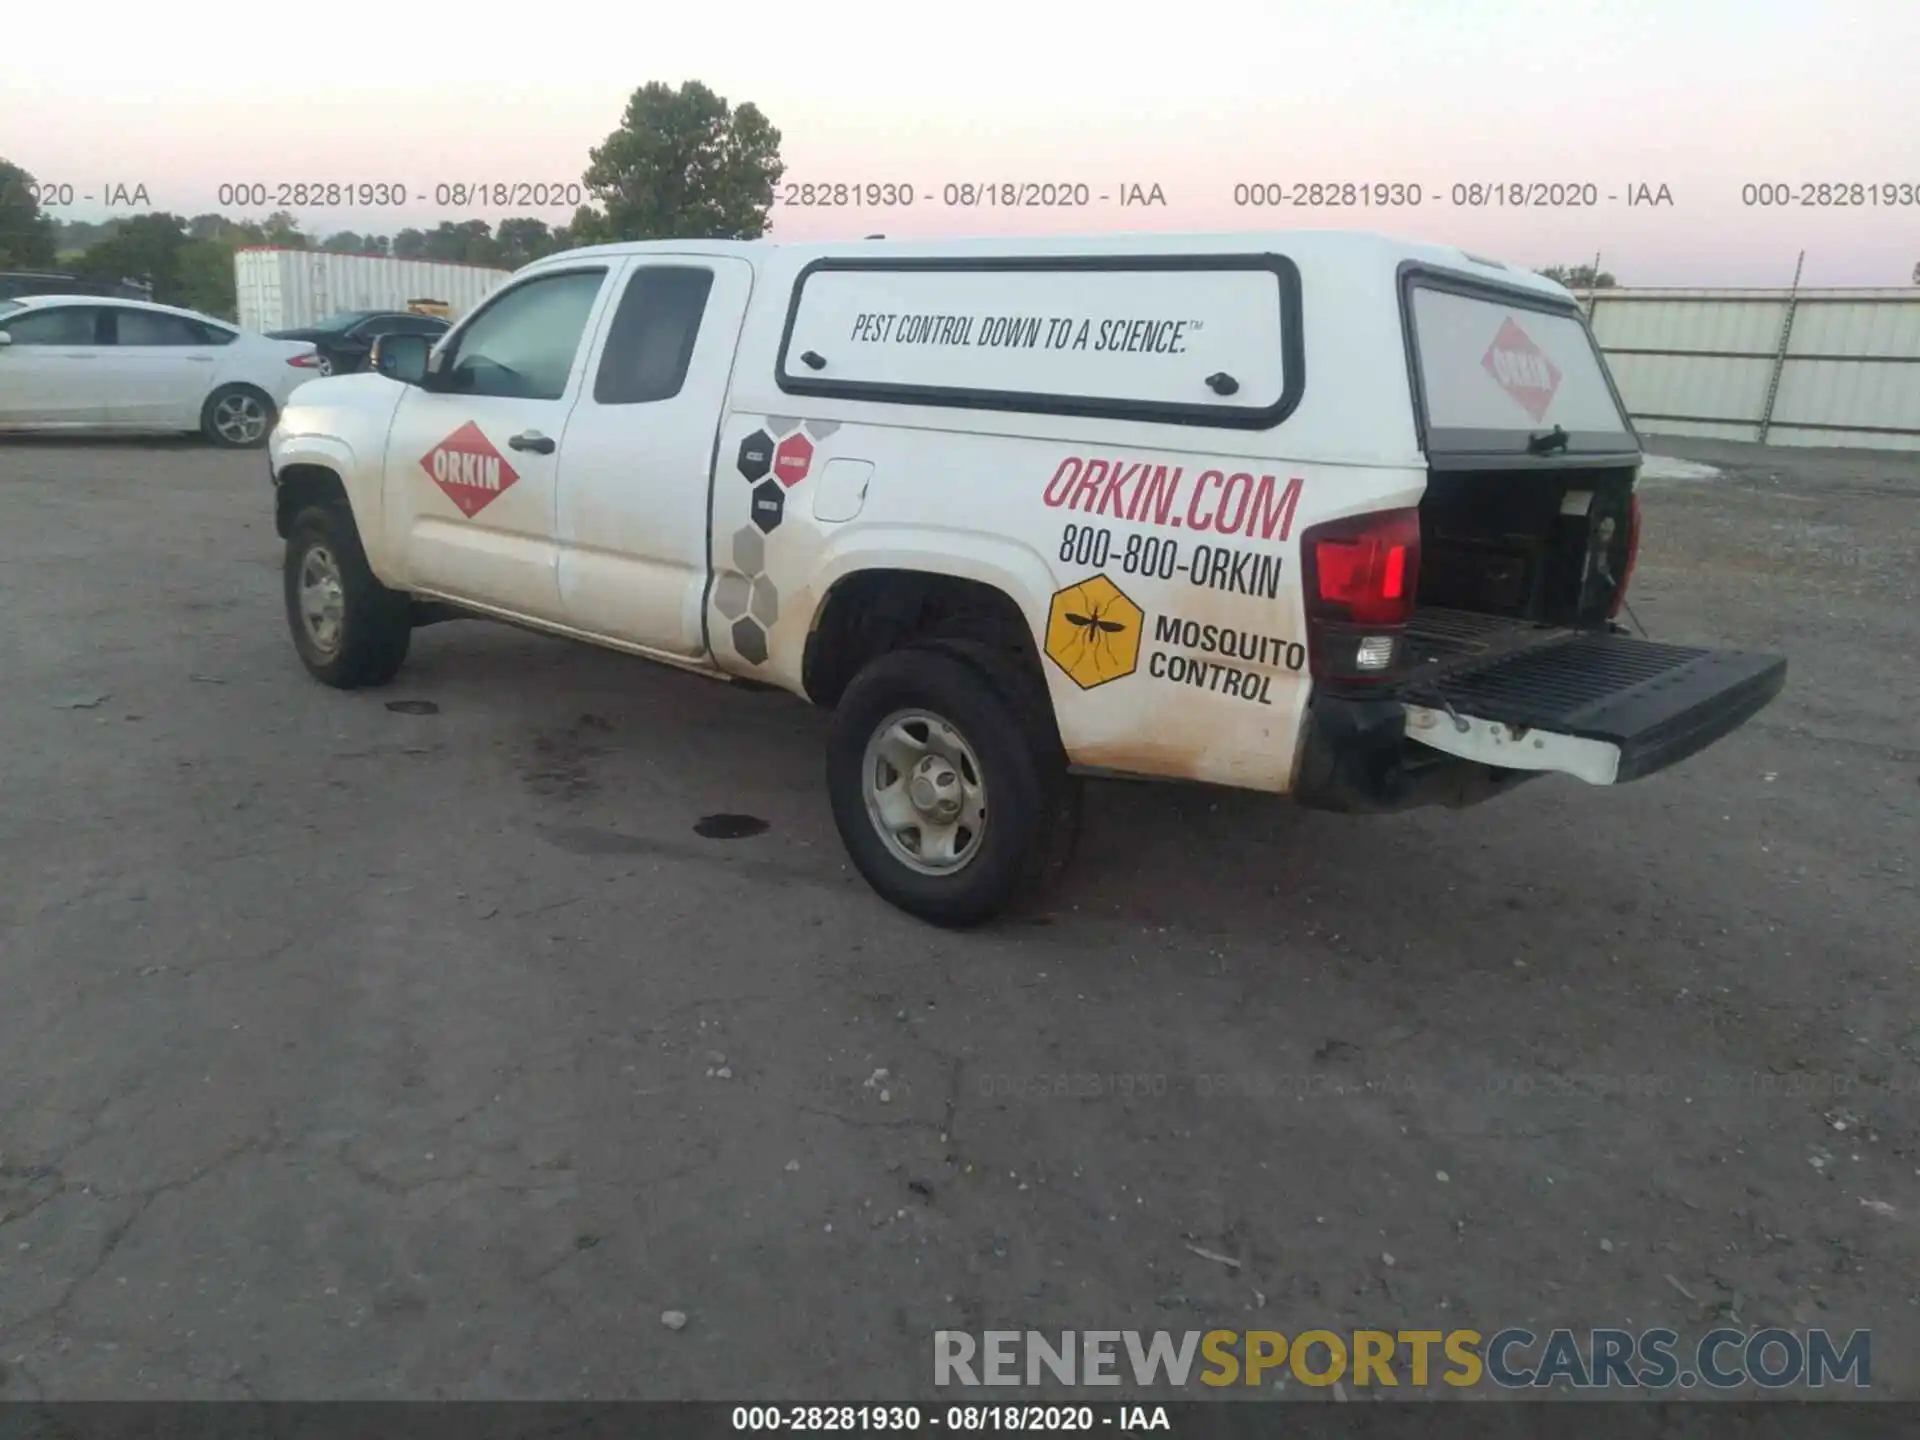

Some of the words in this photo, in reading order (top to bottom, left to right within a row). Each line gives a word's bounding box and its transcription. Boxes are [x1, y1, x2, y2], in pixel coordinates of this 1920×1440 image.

[851, 313, 898, 343] PEST
[895, 314, 974, 346] CONTROL
[977, 316, 1043, 349] DOWN
[1044, 317, 1073, 351] TO
[1072, 318, 1091, 351] A
[1493, 347, 1552, 390] ORKIN
[433, 448, 501, 492] ORKIN
[1043, 456, 1305, 542] ORKIN.COM
[1059, 523, 1283, 600] 800-800-ORKIN
[1154, 614, 1306, 672] MOSQUITO
[1149, 651, 1273, 706] CONTROL
